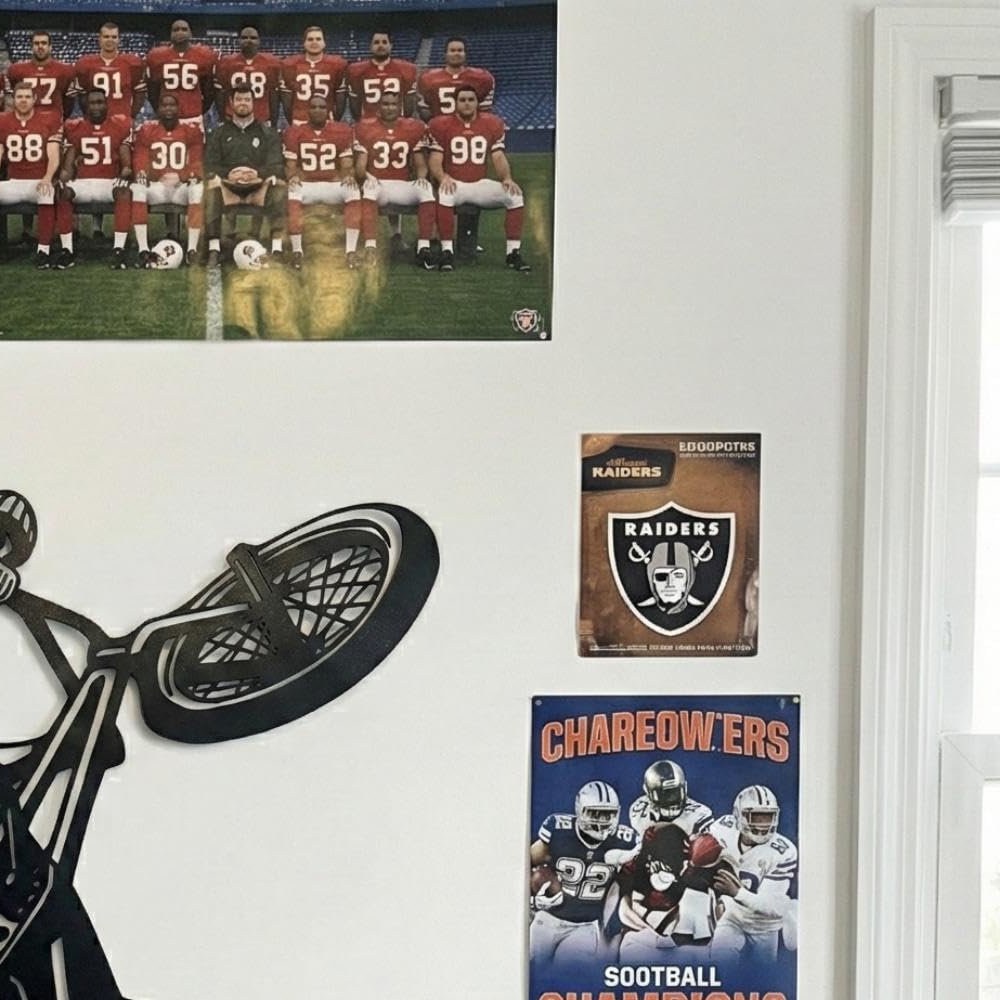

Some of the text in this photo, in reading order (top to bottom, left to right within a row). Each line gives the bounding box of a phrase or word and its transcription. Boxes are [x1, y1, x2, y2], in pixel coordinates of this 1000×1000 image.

[93, 71, 123, 99] 91
[162, 63, 199, 90] 56
[295, 73, 331, 101] 35
[6, 133, 43, 162] 88
[80, 135, 112, 165] 51
[150, 141, 186, 170] 30
[300, 142, 337, 171] 52
[373, 141, 409, 169] 33
[450, 135, 487, 164] 98
[624, 521, 720, 537] RAIDERS
[555, 856, 611, 901] 22
[604, 966, 722, 987] SOOTBALL
